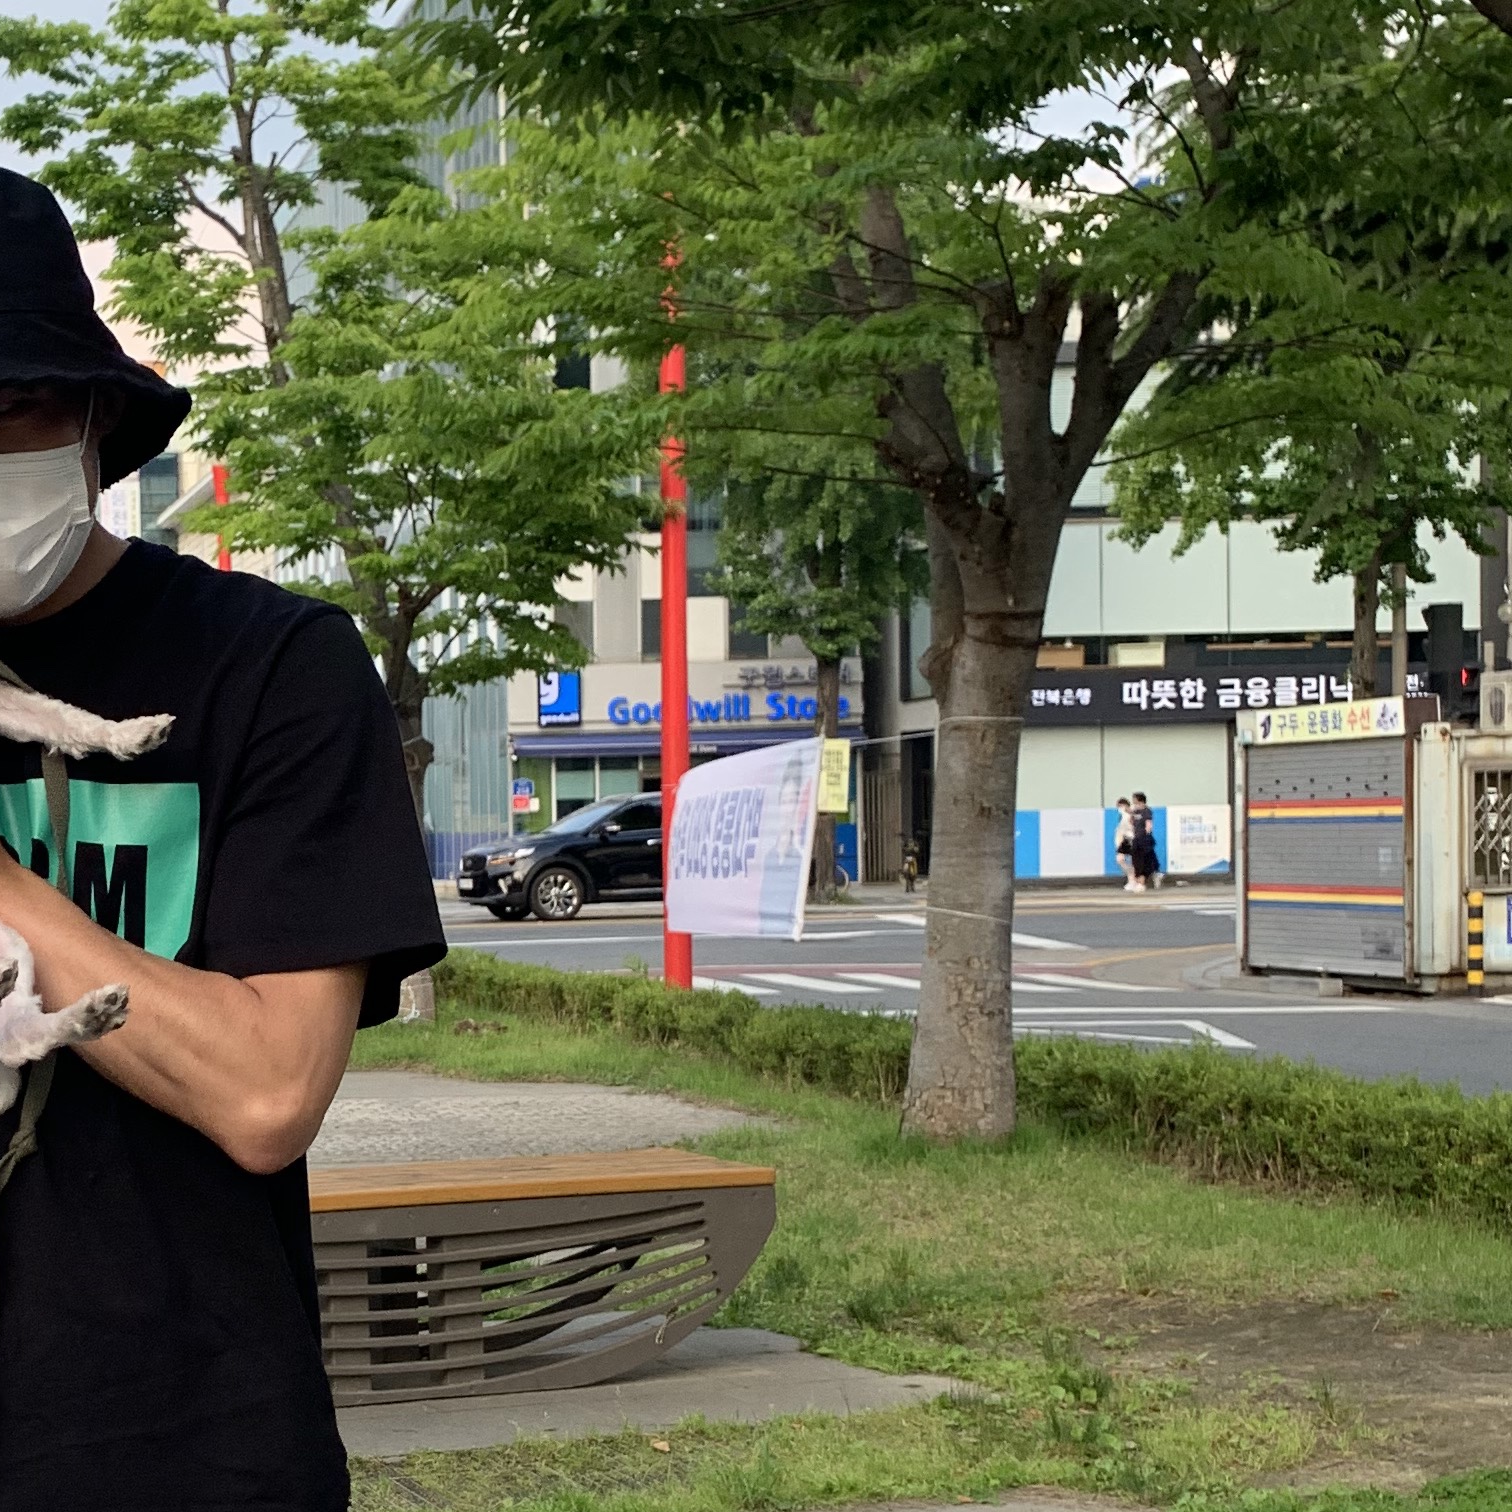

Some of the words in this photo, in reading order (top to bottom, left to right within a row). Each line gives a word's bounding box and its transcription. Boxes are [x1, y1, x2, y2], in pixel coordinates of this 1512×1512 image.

[608, 692, 750, 725] Gowill
[766, 691, 850, 721] Stoe
[1031, 687, 1092, 707] 전북은행
[1121, 677, 1207, 711] 따뜻한
[1346, 707, 1371, 731] 수선
